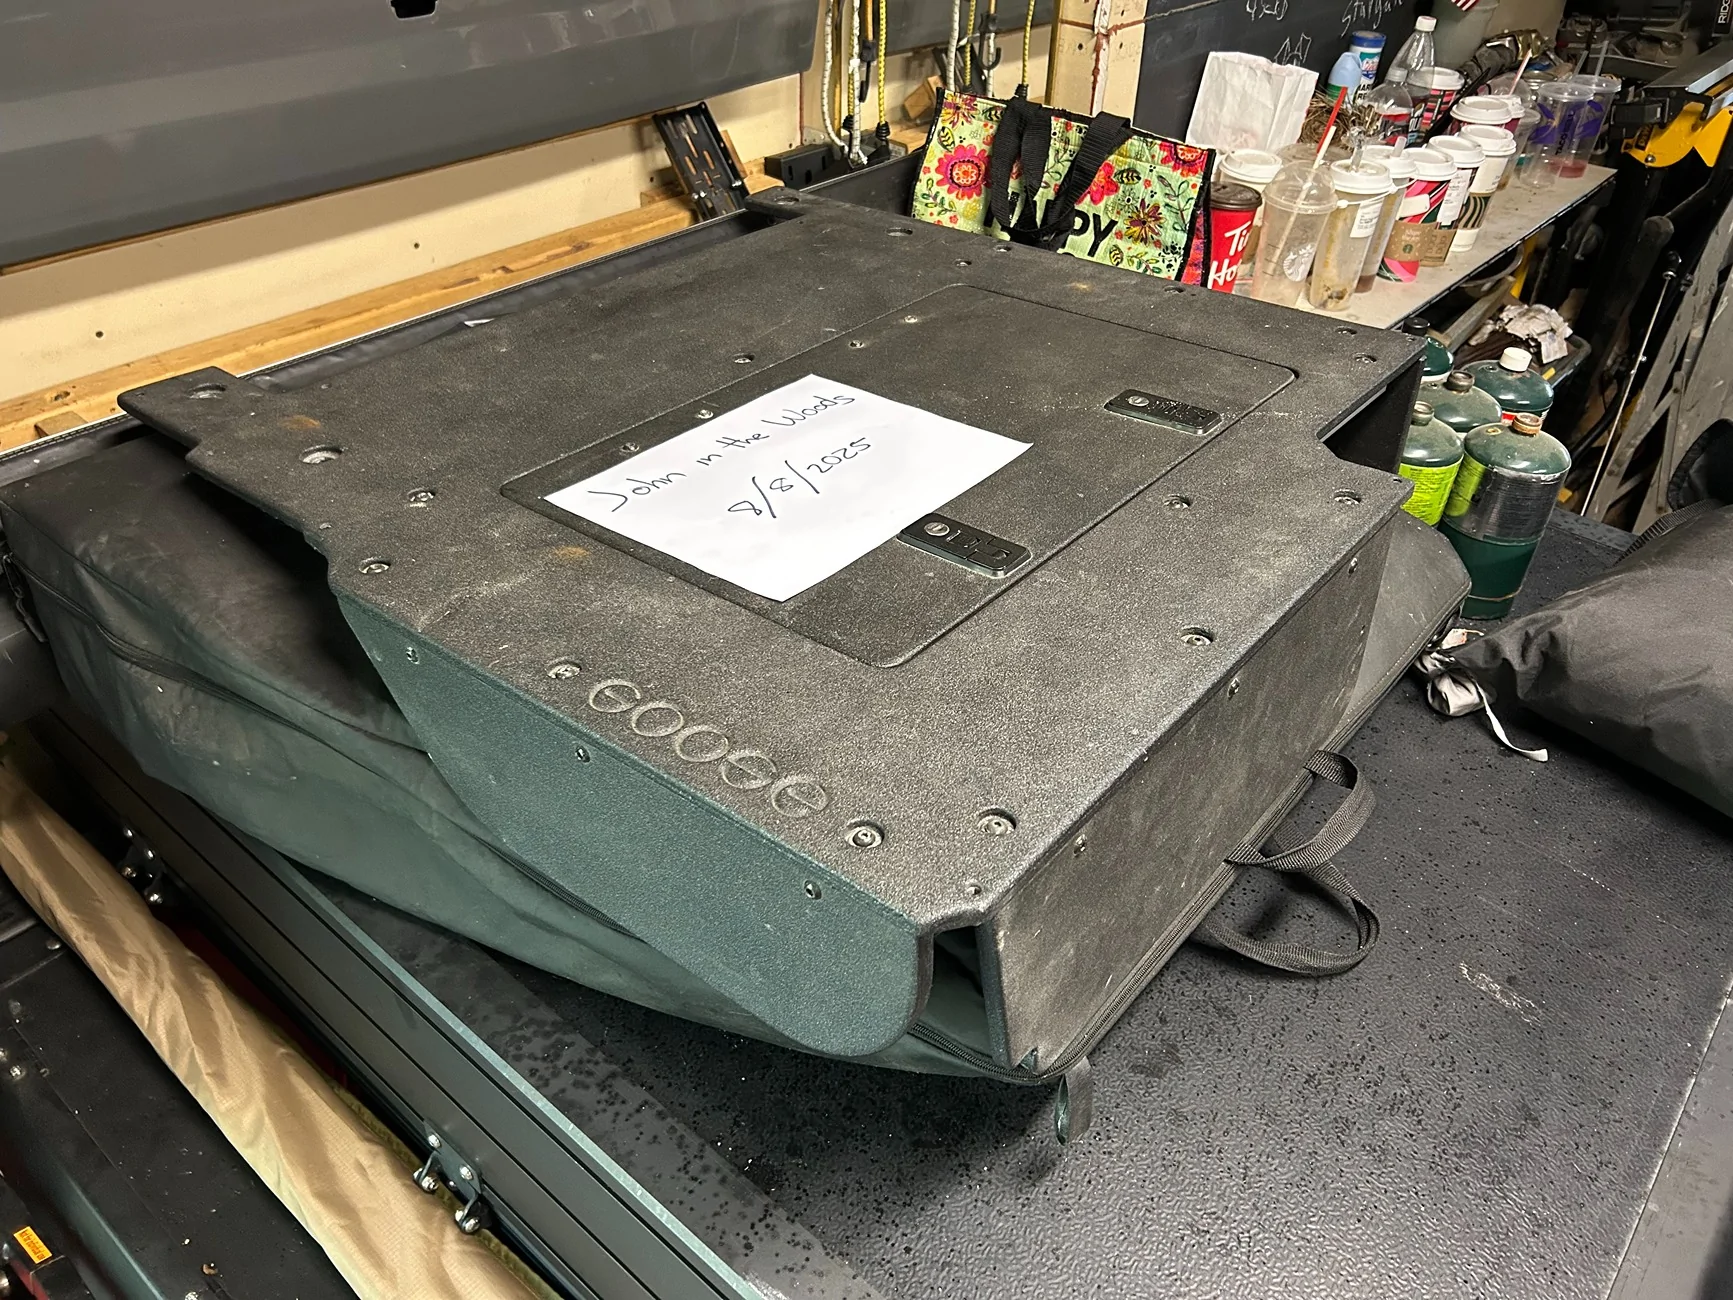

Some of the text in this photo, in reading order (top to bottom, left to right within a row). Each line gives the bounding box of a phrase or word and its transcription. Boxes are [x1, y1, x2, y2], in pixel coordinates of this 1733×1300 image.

[1718, 0, 1731, 24] RIDG
[1224, 220, 1251, 256] Ti
[587, 395, 856, 512] John in the Woods
[727, 436, 871, 519] 8/8/2025
